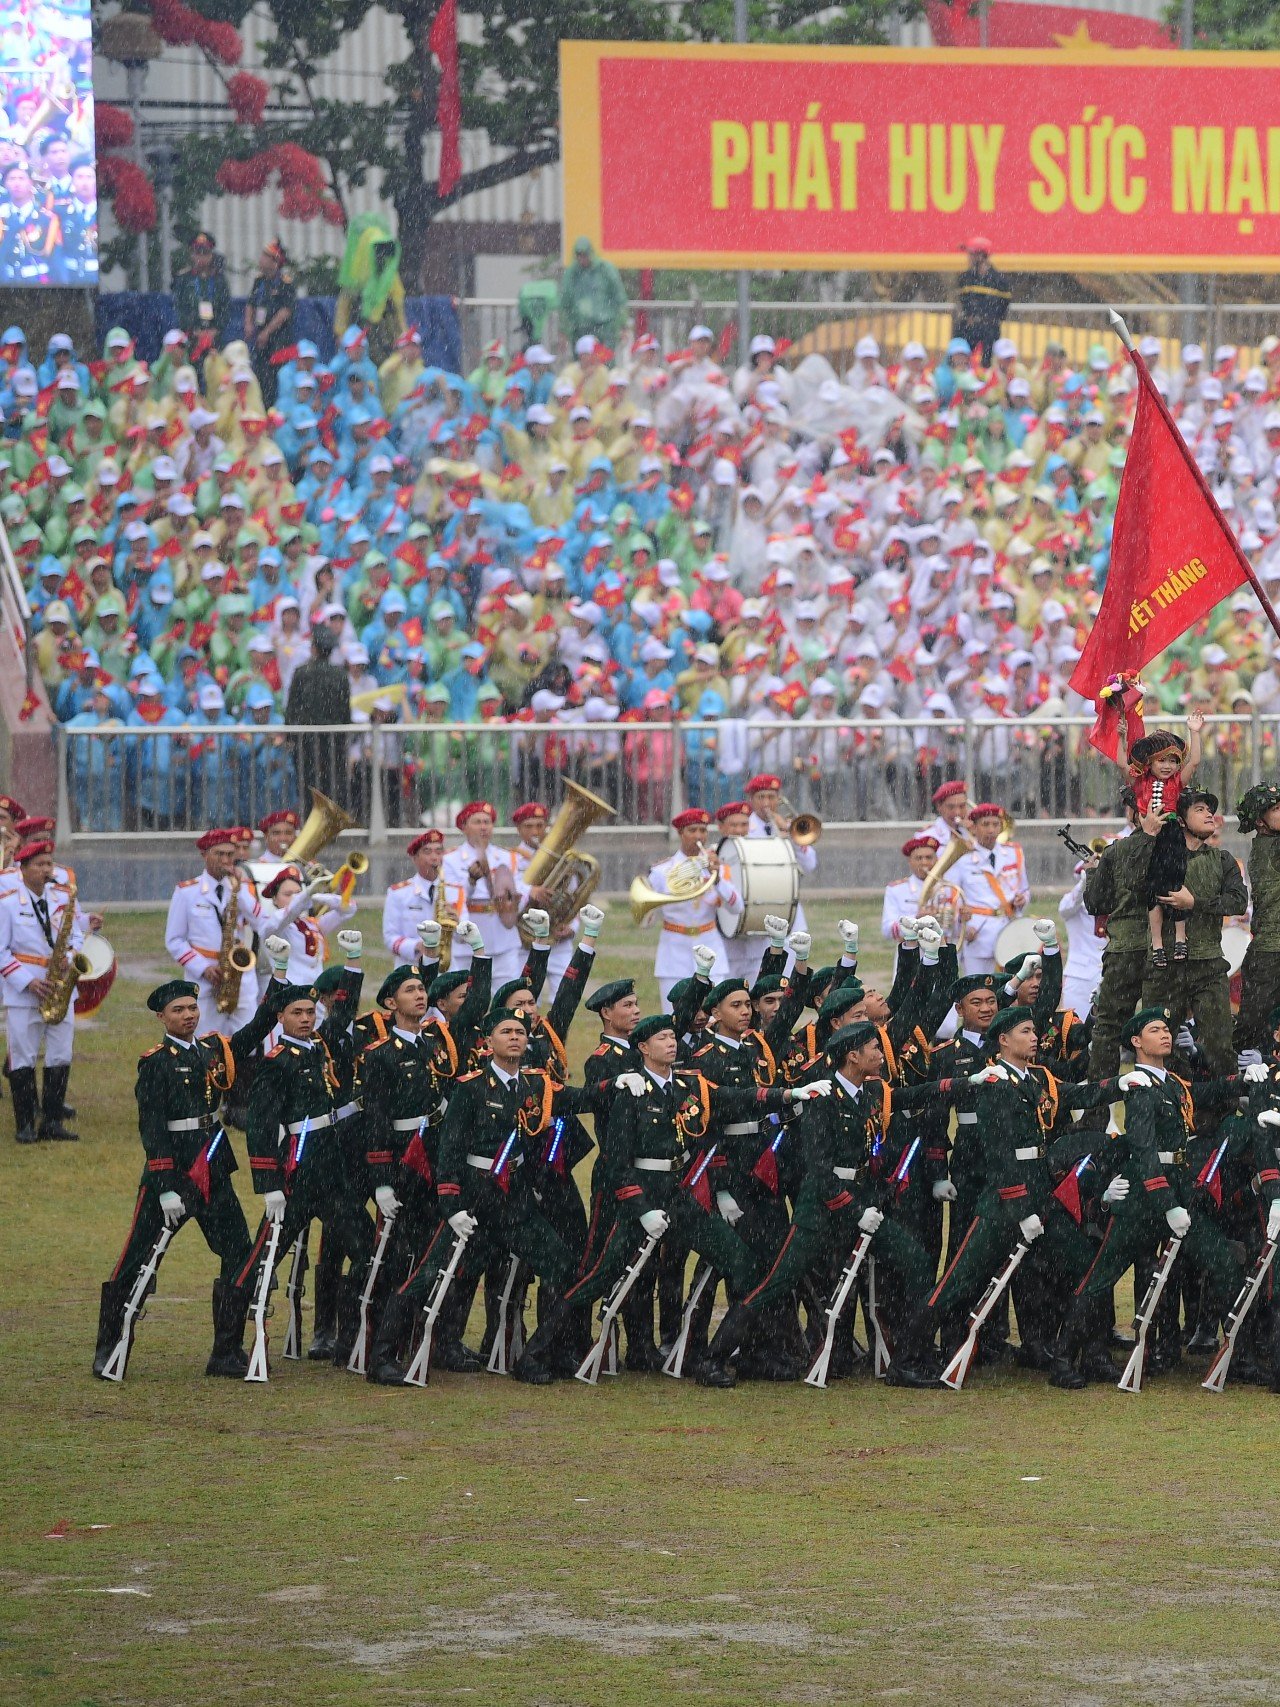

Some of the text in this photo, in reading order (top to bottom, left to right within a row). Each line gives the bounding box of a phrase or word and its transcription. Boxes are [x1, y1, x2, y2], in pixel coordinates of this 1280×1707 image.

[710, 101, 867, 211] PHÁT
[888, 121, 1006, 217] HUY
[1028, 104, 1148, 216] SỨC
[1150, 557, 1208, 609] THẮNG
